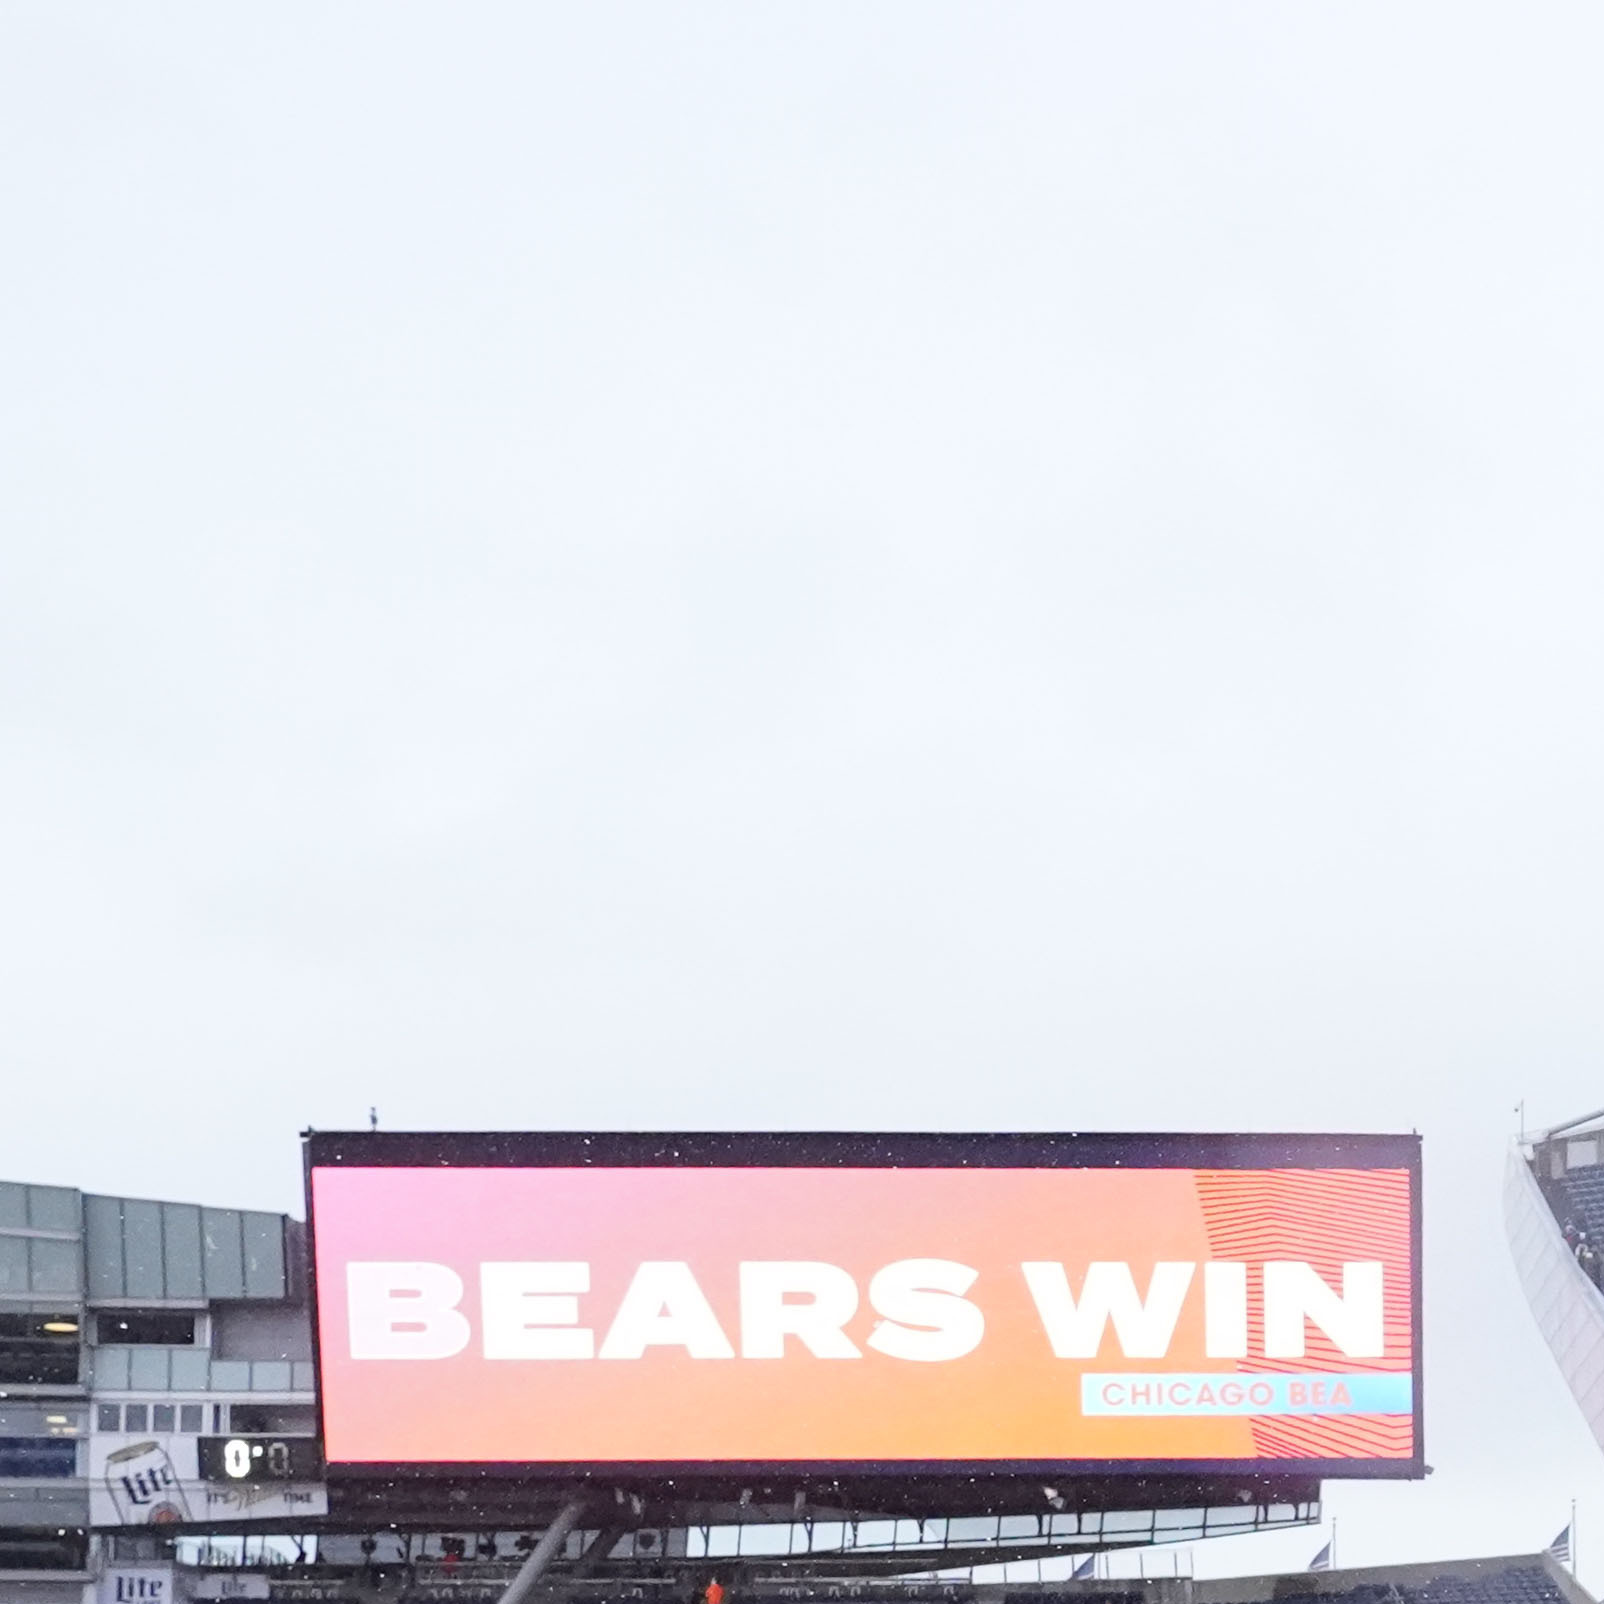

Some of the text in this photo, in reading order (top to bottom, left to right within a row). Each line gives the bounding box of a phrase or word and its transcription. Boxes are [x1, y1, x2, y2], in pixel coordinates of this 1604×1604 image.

[346, 1258, 1384, 1361] BEARS WIN
[1102, 1382, 1354, 1406] CHICAGO BEA
[116, 1576, 162, 1603] Lite
